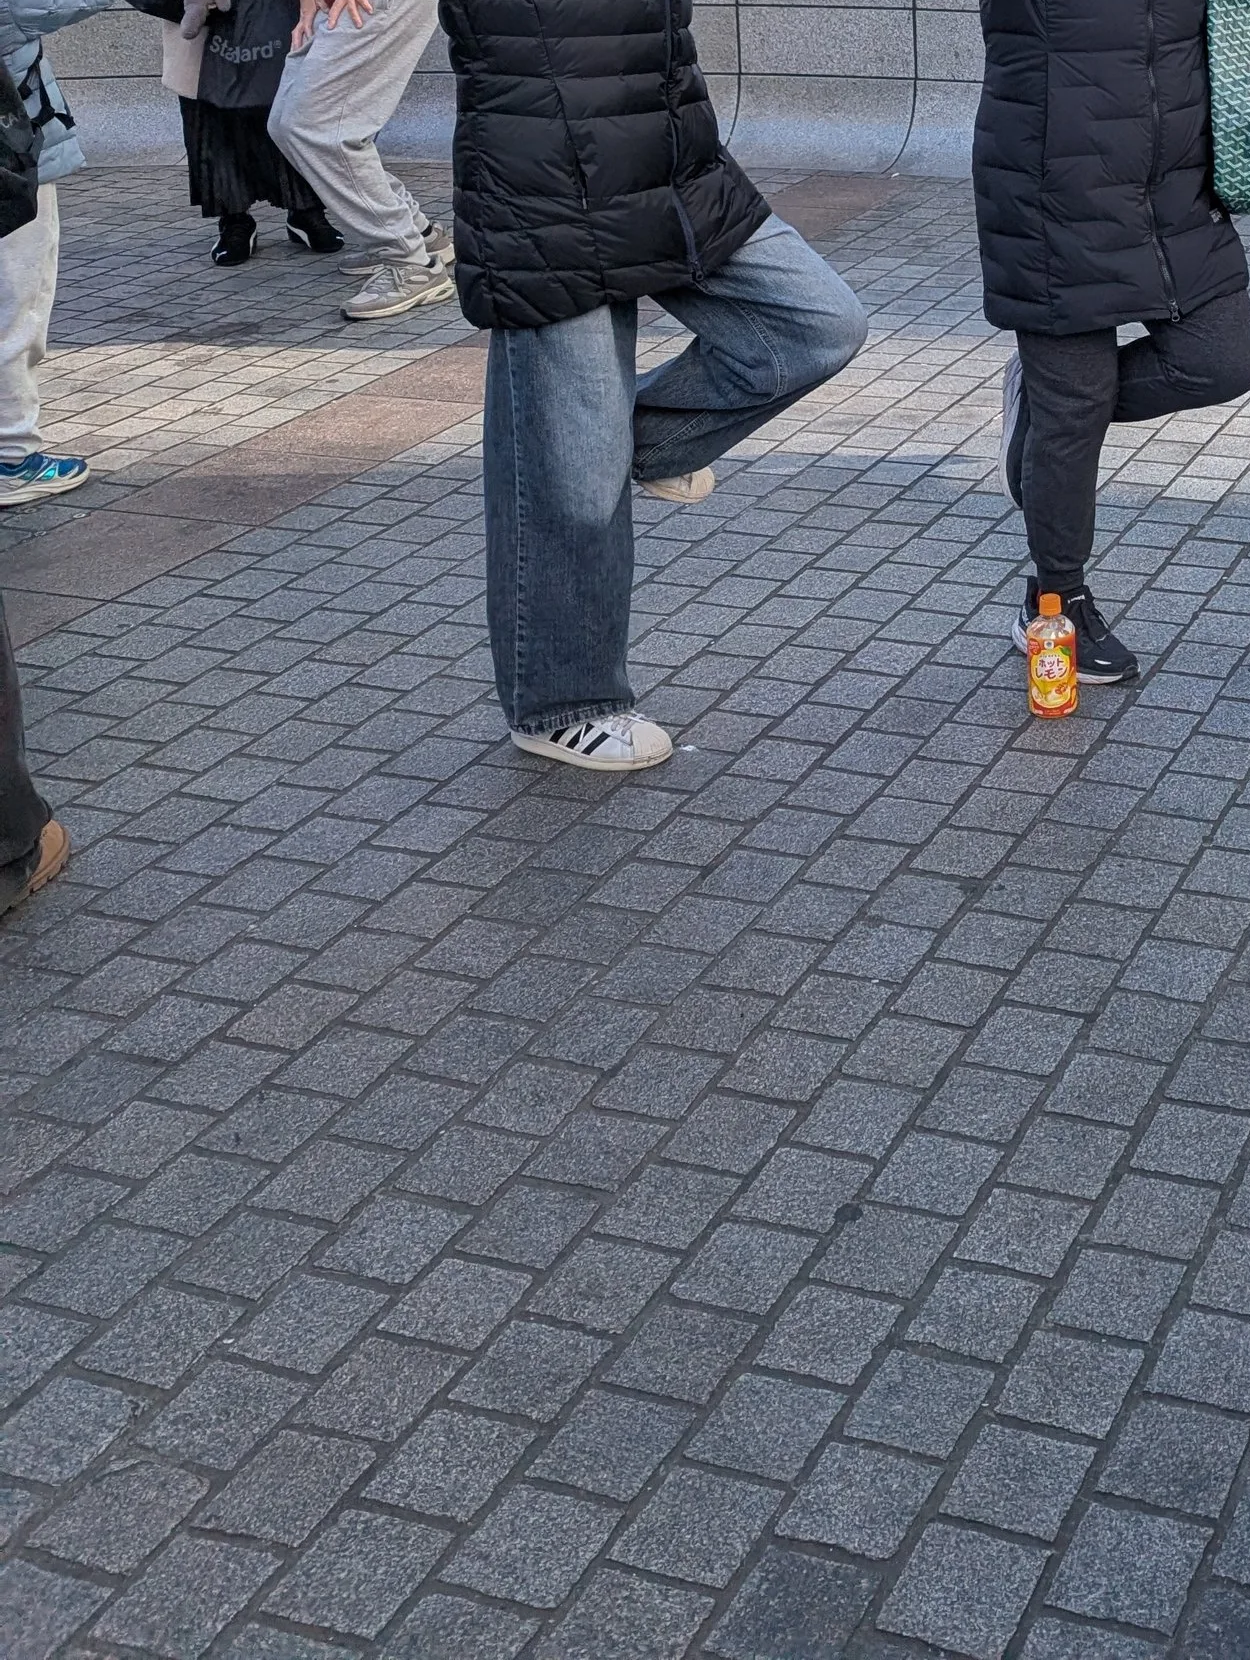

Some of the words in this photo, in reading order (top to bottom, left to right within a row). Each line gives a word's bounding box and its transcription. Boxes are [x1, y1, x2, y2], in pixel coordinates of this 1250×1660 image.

[1039, 657, 1065, 668] ホット
[1035, 666, 1068, 680] レモン
